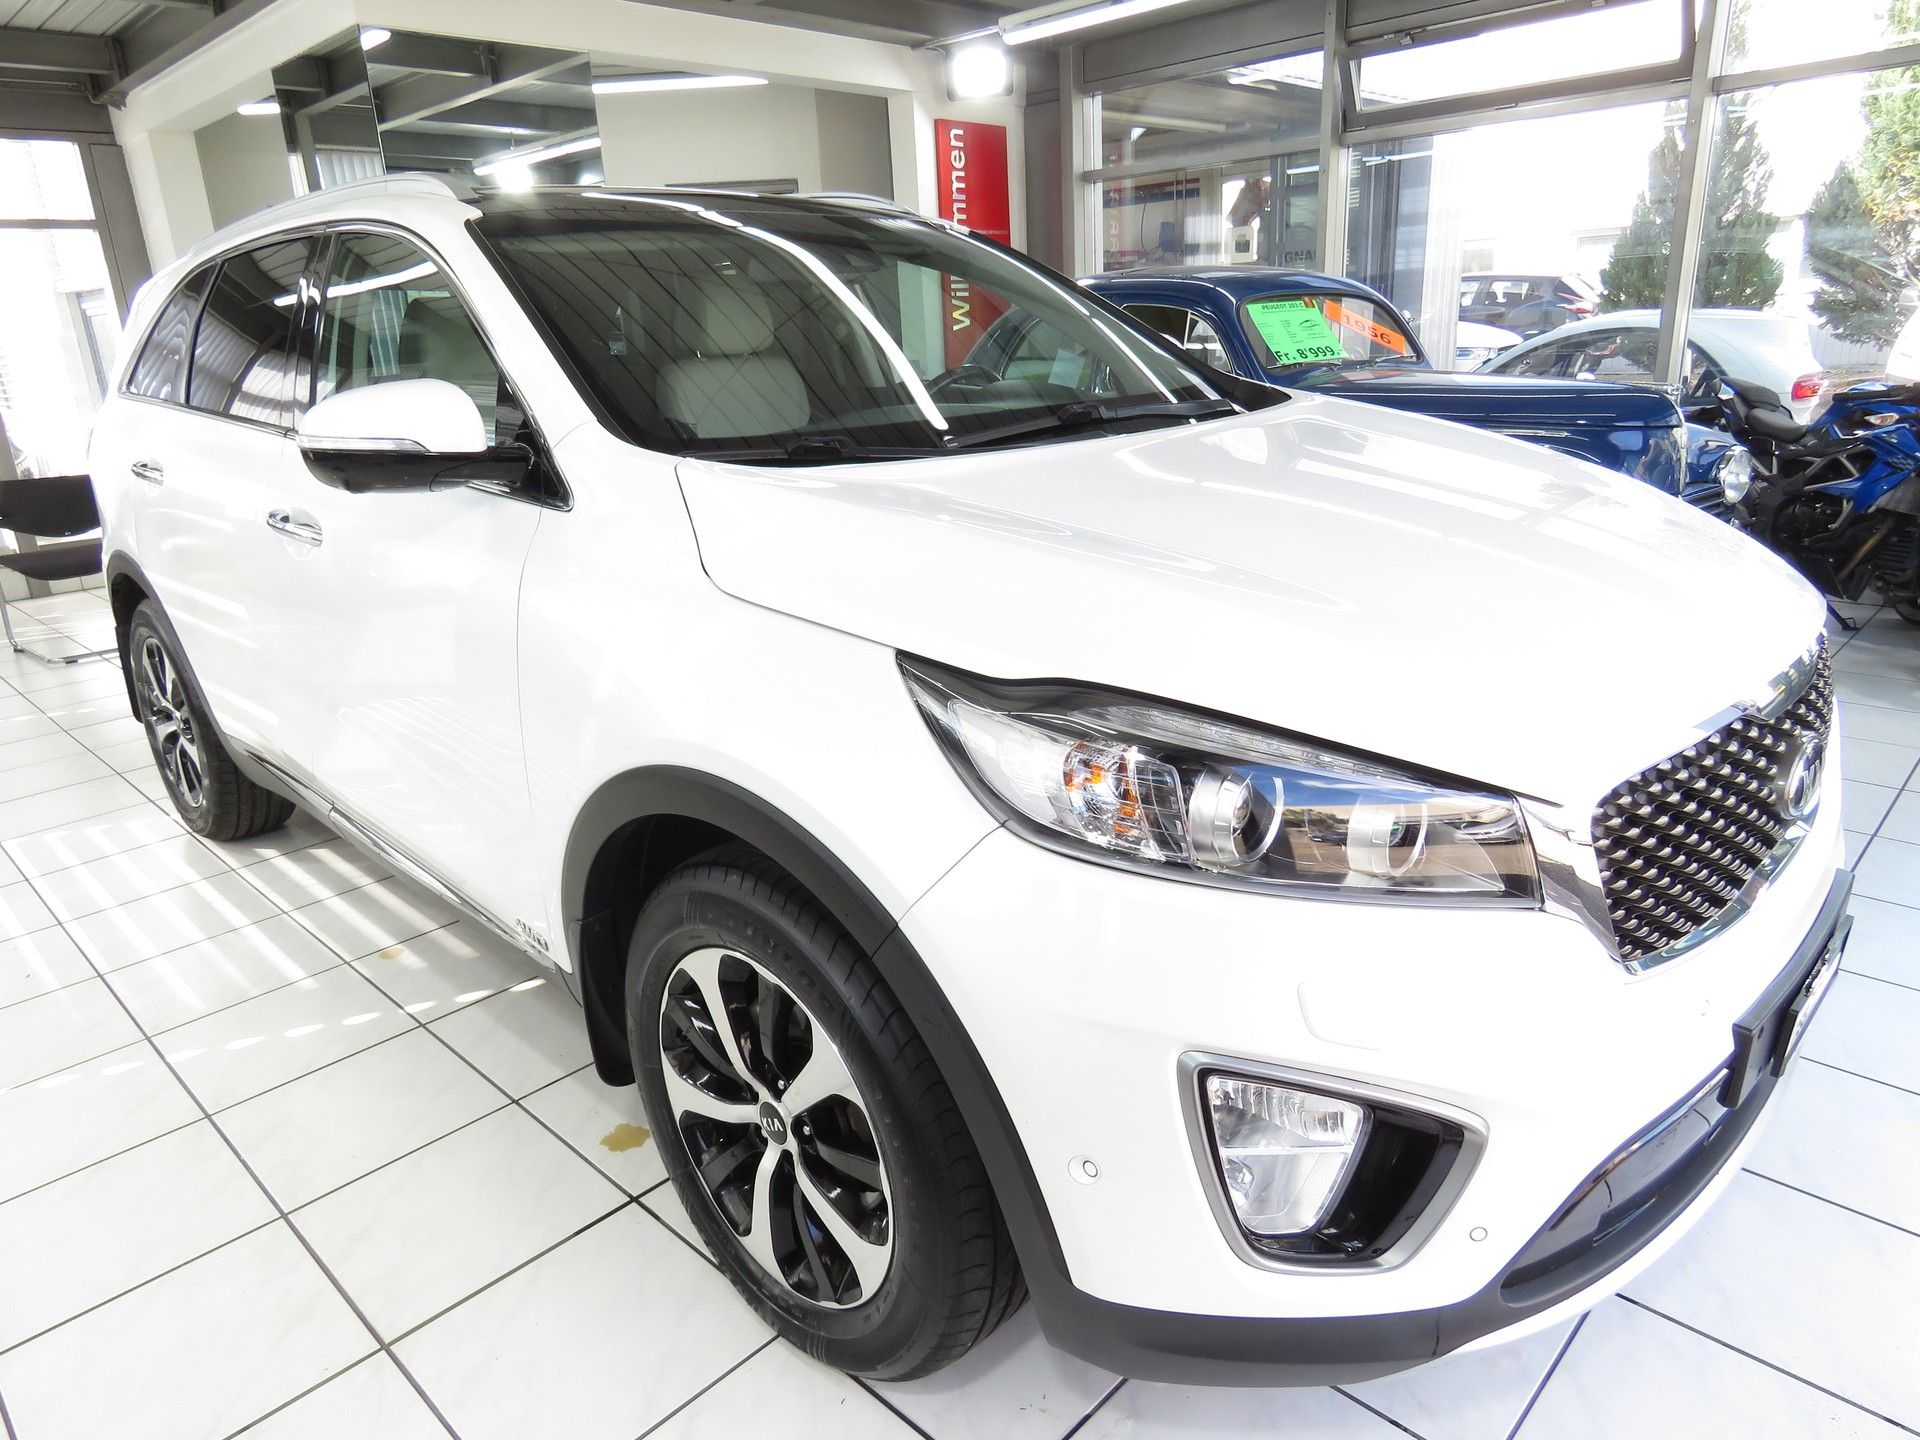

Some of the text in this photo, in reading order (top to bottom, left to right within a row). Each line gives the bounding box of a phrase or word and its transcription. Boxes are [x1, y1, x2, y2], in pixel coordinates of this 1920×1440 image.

[1343, 314, 1392, 345] 1956
[1274, 350, 1296, 361] Fr.
[761, 1117, 784, 1131] KIA
